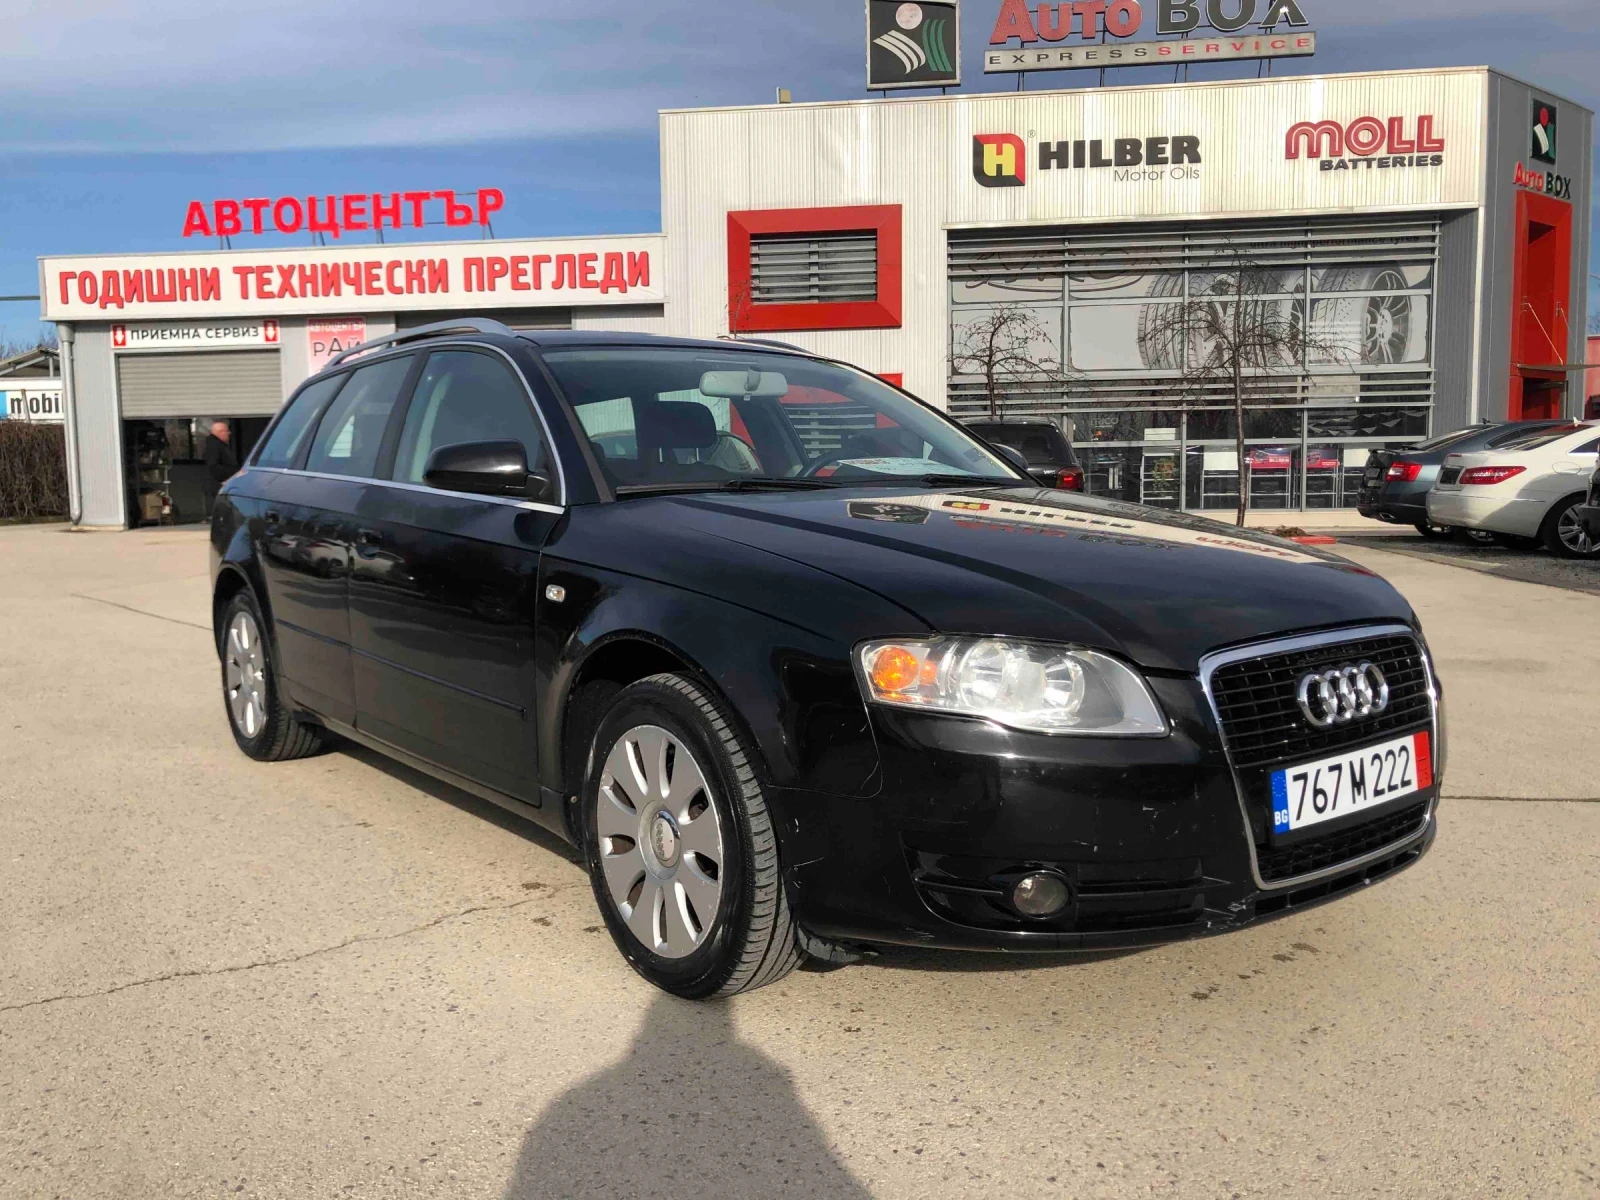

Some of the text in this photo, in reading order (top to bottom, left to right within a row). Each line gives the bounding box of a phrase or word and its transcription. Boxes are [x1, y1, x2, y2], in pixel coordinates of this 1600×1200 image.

[989, 0, 1143, 44] AUTO
[1038, 136, 1202, 171] HILBER
[1320, 155, 1444, 171] BATTERIES
[1114, 166, 1201, 183] Motor Oils
[1544, 171, 1572, 200] BOX
[182, 188, 504, 238] АВТОЦЕНТЪР
[59, 251, 650, 310] ГОДИШНИ ТЕХНИЧЕСКИ ПРЕГЛЕДИ
[131, 326, 259, 341] ПРИЕМНА СЕРВИЗ
[1292, 764, 1343, 821] 767
[1348, 757, 1368, 804] M
[1371, 745, 1413, 798] 222
[1274, 808, 1289, 826] BG
